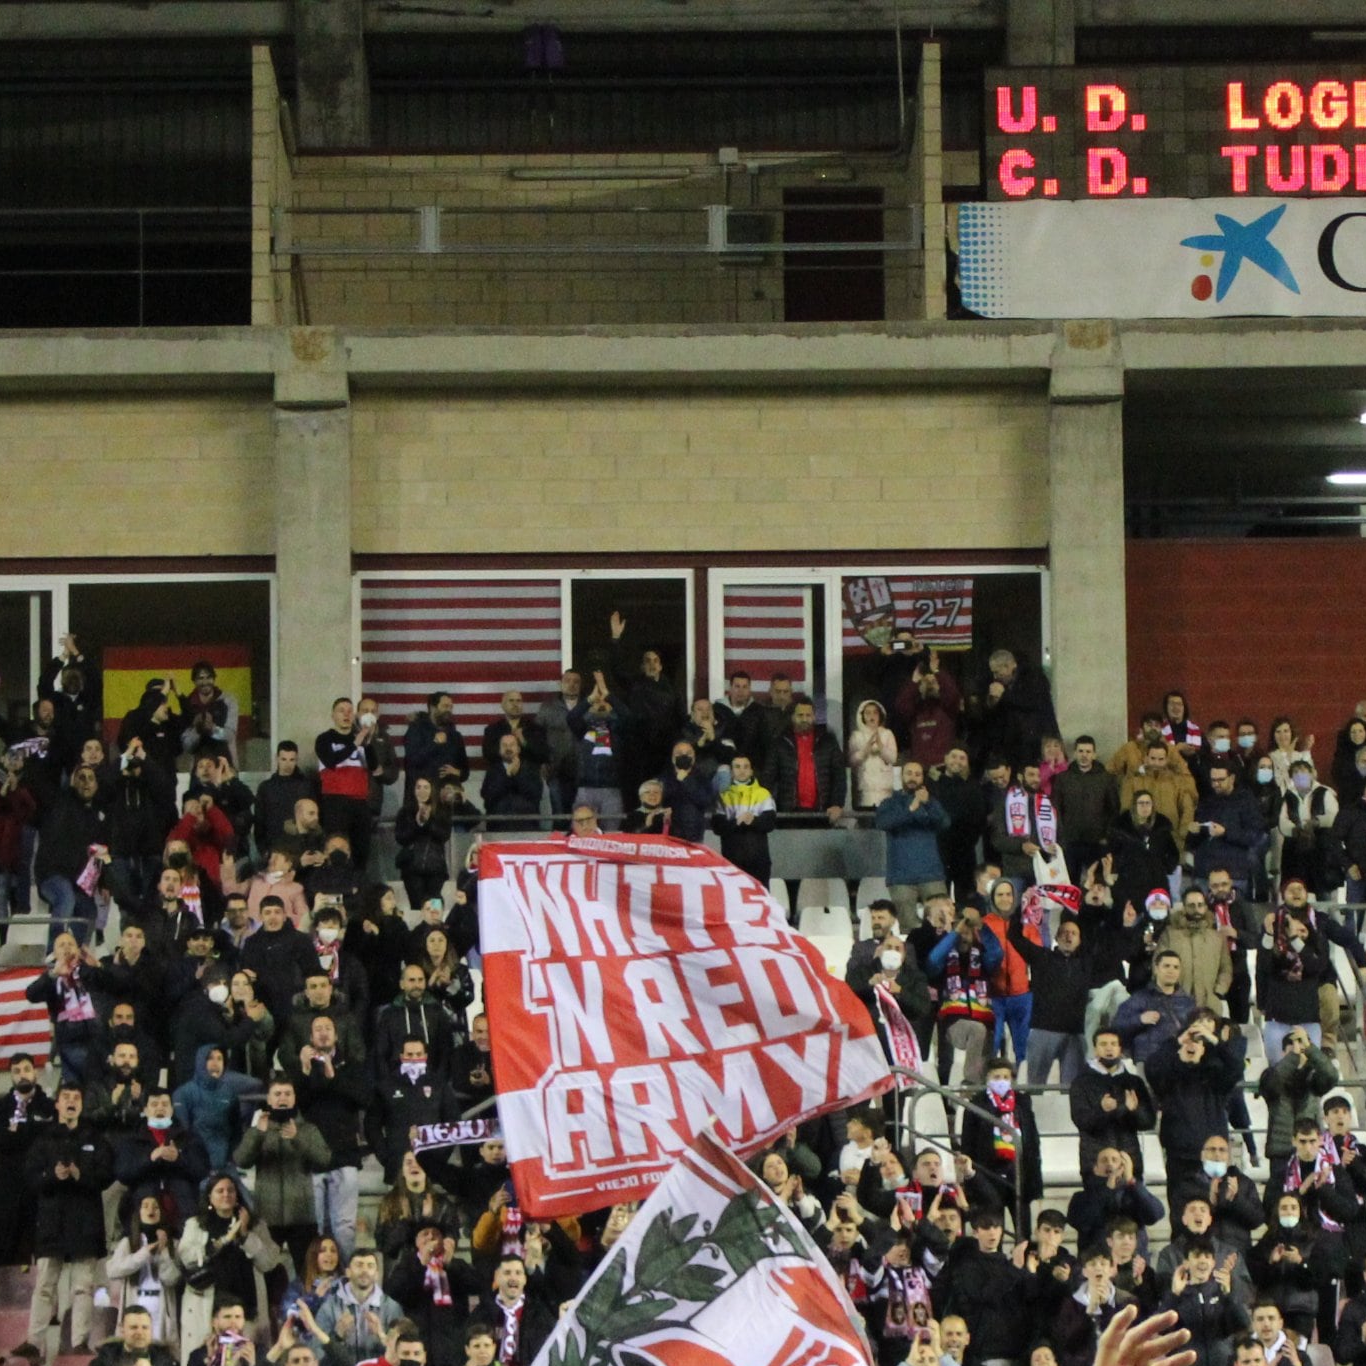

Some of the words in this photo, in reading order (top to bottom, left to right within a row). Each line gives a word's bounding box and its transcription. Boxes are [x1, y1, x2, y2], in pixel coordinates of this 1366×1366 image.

[996, 85, 1056, 133] U.
[1085, 85, 1147, 133] D.
[996, 149, 1058, 196] C.
[1085, 148, 1147, 195] D.
[913, 597, 963, 629] 27
[503, 861, 782, 959] WHITE
[623, 946, 822, 1060] RED
[546, 1032, 832, 1165] ARMY
[596, 1175, 640, 1192] VIEJO
